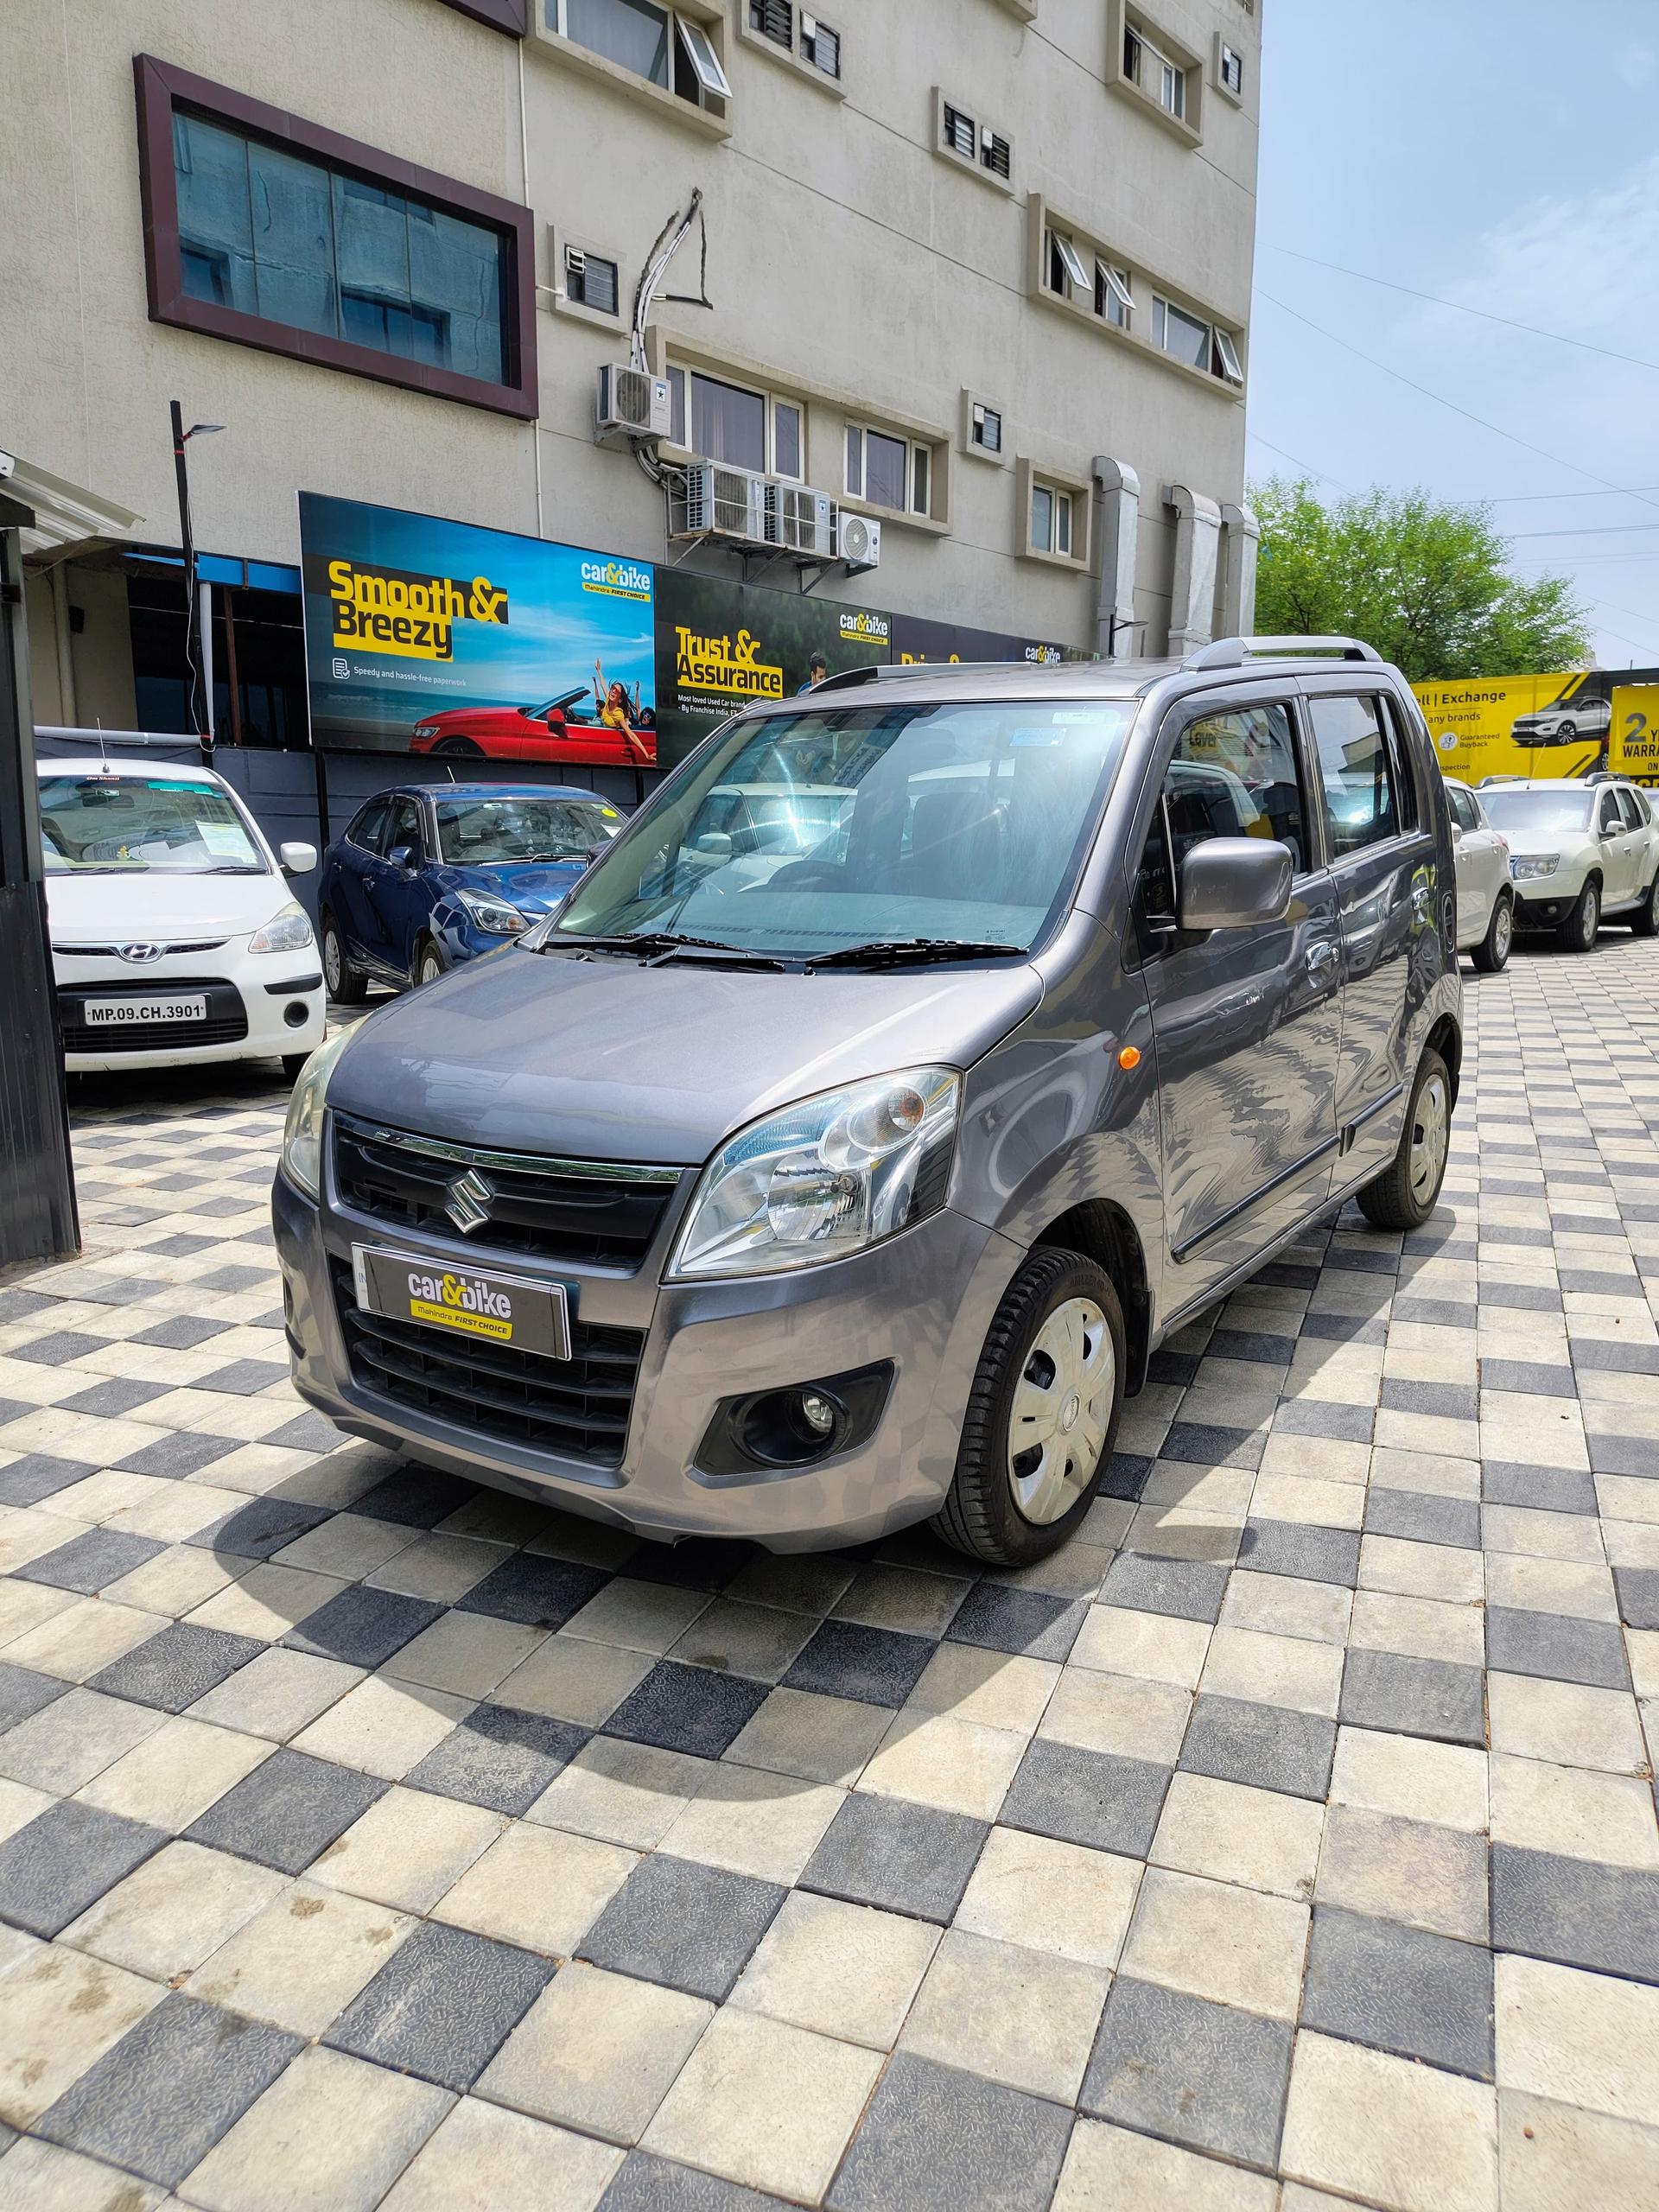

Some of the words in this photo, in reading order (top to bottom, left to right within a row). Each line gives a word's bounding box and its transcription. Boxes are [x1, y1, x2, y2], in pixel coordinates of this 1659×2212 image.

[581, 563, 651, 591] car&bike
[328, 561, 464, 619] Smooth
[469, 576, 508, 624] &
[331, 599, 452, 658] Breezy
[839, 613, 888, 636] car&bike
[676, 626, 730, 662] Trust
[735, 629, 760, 664] &
[1025, 645, 1061, 664] car&bike
[353, 666, 380, 677] Speedy
[395, 671, 432, 683] hassle-free
[433, 677, 467, 686] paperwork
[677, 654, 781, 693] Assurance
[677, 694, 692, 702] Most
[692, 695, 707, 704] loved
[708, 696, 721, 706] Used
[1442, 691, 1506, 704] Exchange
[681, 703, 690, 714] By
[690, 705, 715, 715] Franchise
[1427, 716, 1445, 725] any
[1447, 712, 1481, 722] brands
[1459, 733, 1500, 741] Guaranteed
[1624, 712, 1648, 743] 2
[1459, 741, 1488, 749] Buyback
[1623, 744, 1659, 758] WARR
[92, 1004, 200, 1021] MP.09.CH.3901
[408, 1273, 512, 1319] car&bike
[454, 1315, 478, 1327] FIRST
[478, 1321, 508, 1335] CHOICE
